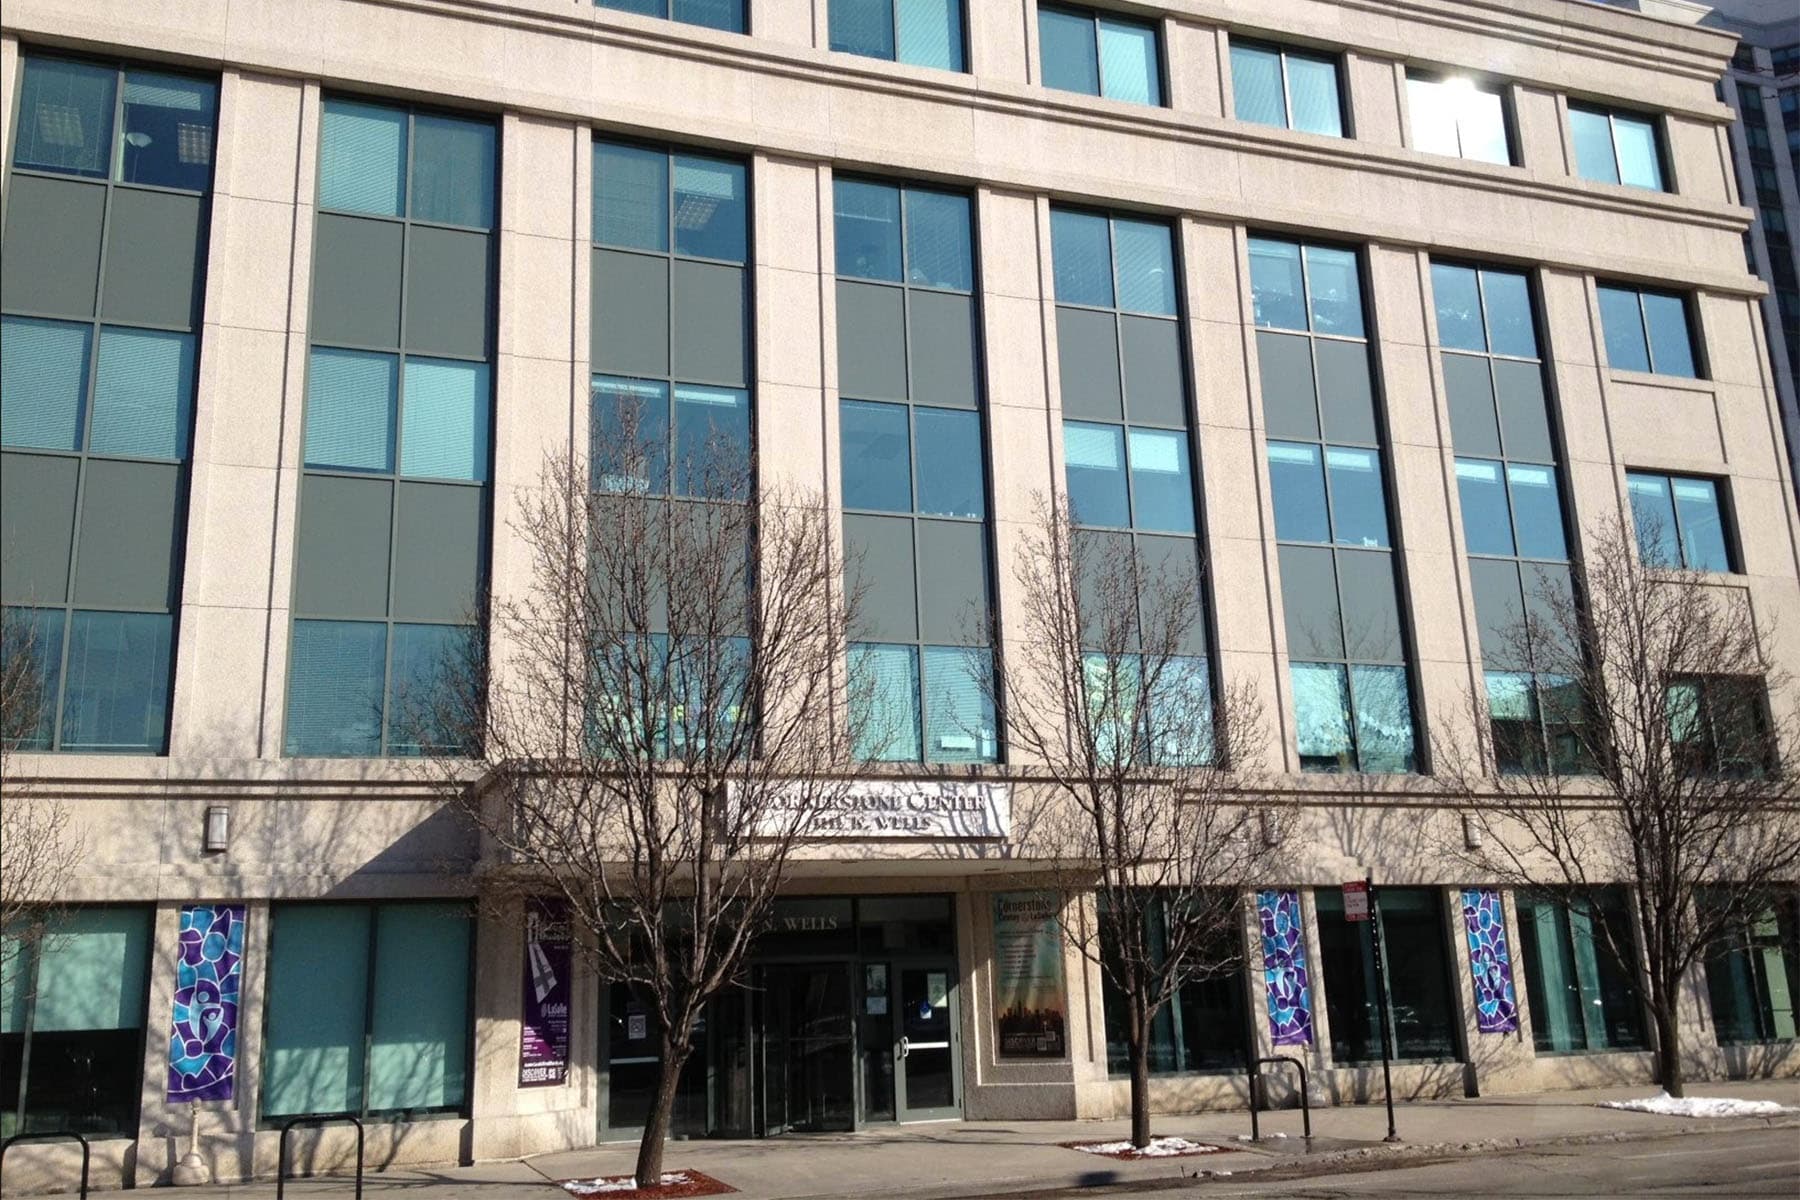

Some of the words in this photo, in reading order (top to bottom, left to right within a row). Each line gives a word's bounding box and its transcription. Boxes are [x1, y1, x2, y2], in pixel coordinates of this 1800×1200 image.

[906, 791, 985, 811] CENTER
[875, 816, 933, 831] WELLS
[784, 915, 837, 931] WELLS
